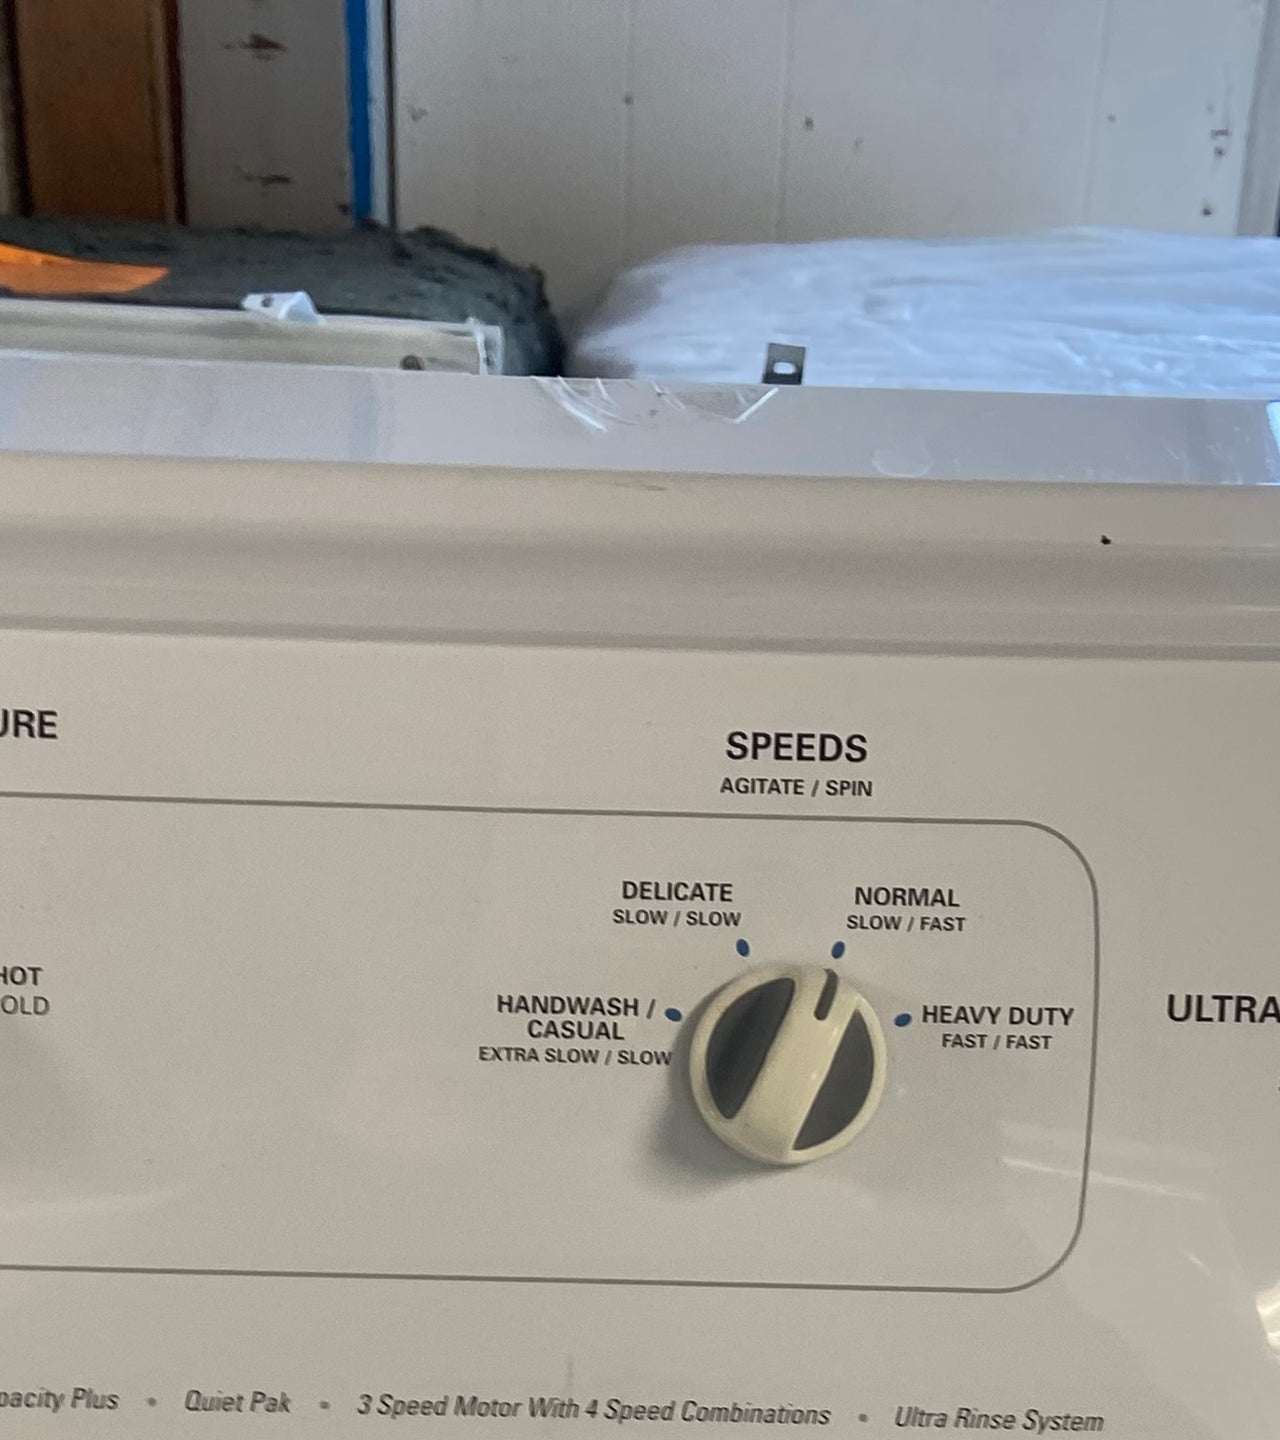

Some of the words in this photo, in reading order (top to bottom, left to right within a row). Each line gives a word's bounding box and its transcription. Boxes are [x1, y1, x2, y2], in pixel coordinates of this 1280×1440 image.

[725, 731, 869, 763] SPEEDS
[720, 777, 805, 796] AGITATE
[811, 780, 820, 797] /
[825, 779, 873, 797] SPIN
[622, 880, 734, 903] DELICATE
[855, 886, 960, 908] NORMAL
[612, 909, 668, 926] SLOW
[673, 910, 681, 927] /
[686, 910, 742, 927] SLOW
[846, 914, 902, 931] SLOW
[908, 915, 915, 932] /
[920, 915, 967, 933] FAST
[496, 994, 639, 1018] HANDWASH
[645, 999, 656, 1019] /
[922, 1004, 1003, 1026] HEAVY
[1009, 1006, 1075, 1026] DUTY
[527, 1019, 624, 1040] CASUAL
[941, 1033, 988, 1050] FAST
[993, 1034, 1001, 1050] /
[1005, 1034, 1053, 1051] FAST
[478, 1047, 540, 1064] EXTRA
[544, 1048, 600, 1065] SLOW
[604, 1050, 613, 1066] /
[617, 1049, 673, 1067] SLOW
[71, 1387, 120, 1411] Plus
[184, 1389, 243, 1414] Quiet
[249, 1391, 291, 1413] Pak
[357, 1394, 372, 1415] 3
[377, 1393, 448, 1420] Speed
[454, 1395, 522, 1418] Motor
[528, 1397, 579, 1419] With
[585, 1399, 599, 1419] 4
[603, 1399, 675, 1425] Speed
[681, 1401, 831, 1427] Combinations
[894, 1405, 948, 1430] Ultra
[954, 1407, 1017, 1431] Rinse
[1022, 1409, 1104, 1437] System
